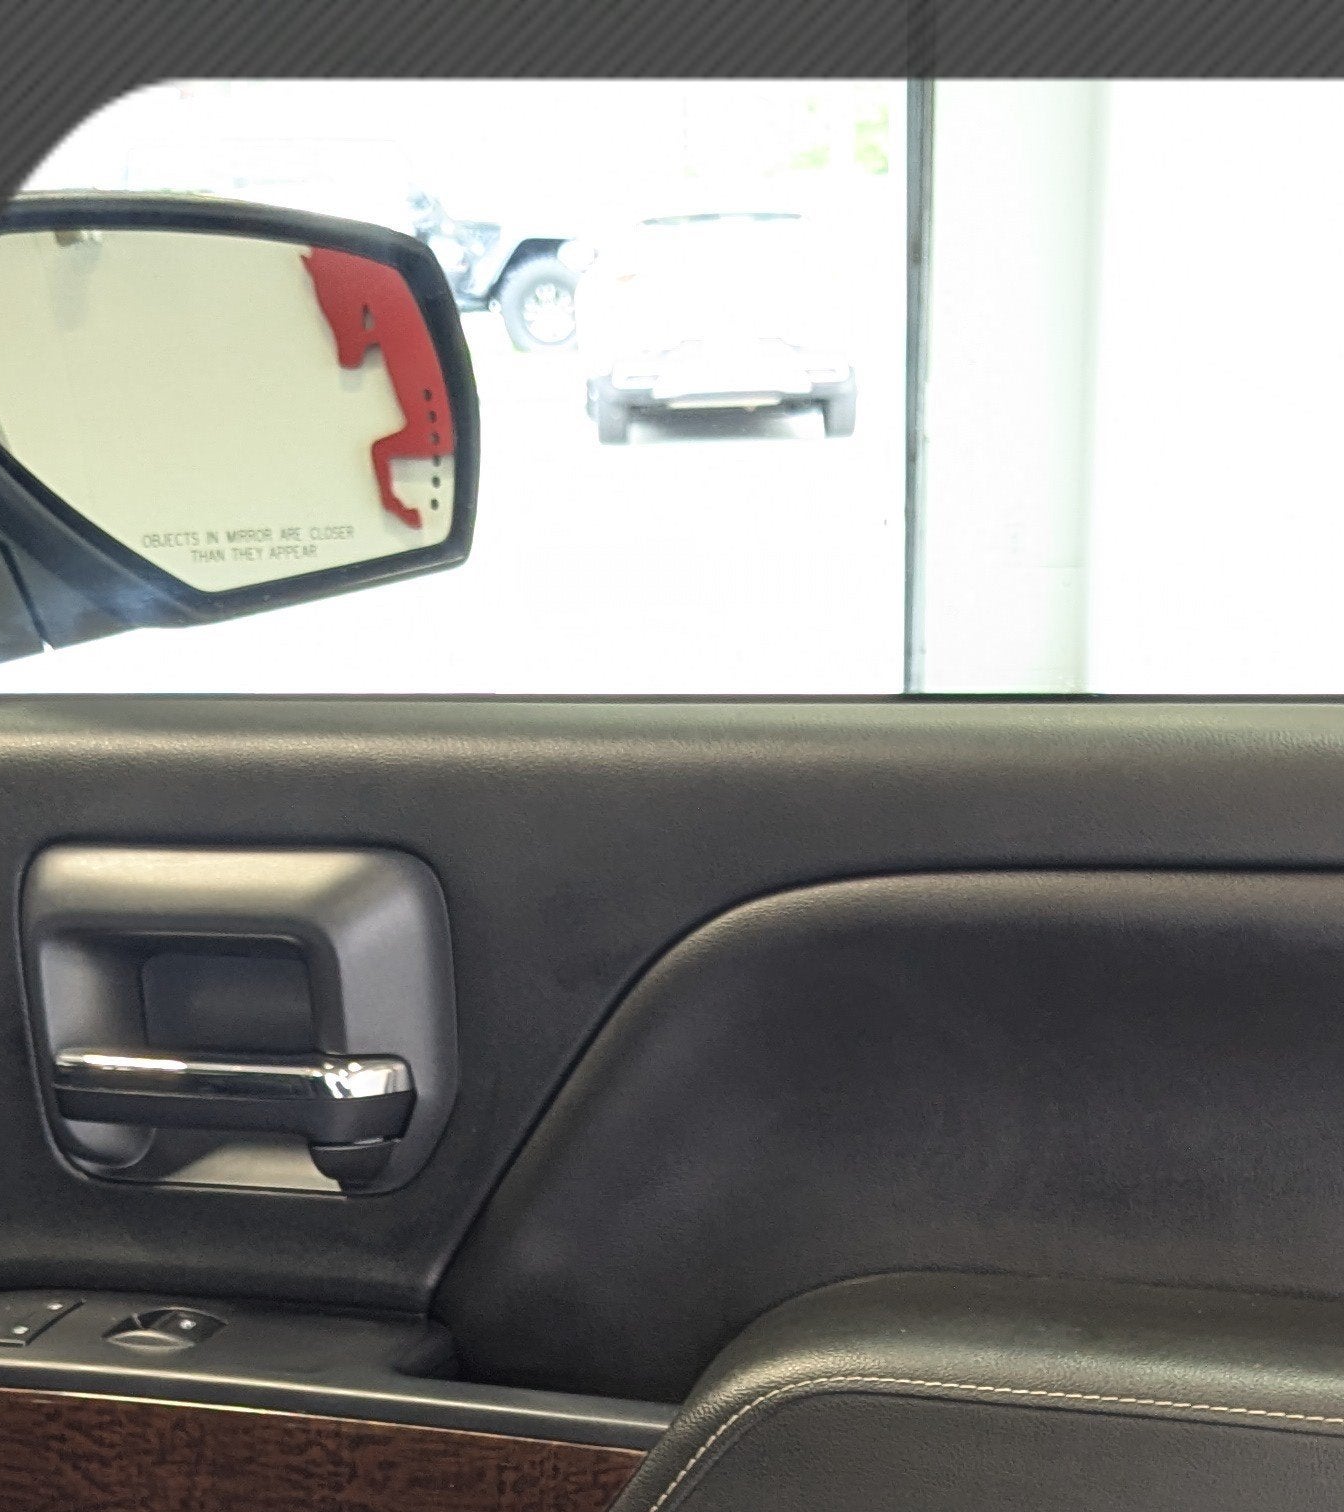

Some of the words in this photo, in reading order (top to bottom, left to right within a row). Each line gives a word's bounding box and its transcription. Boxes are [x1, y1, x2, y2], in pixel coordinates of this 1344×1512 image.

[142, 530, 201, 549] OBJECTS
[206, 530, 220, 545] IN
[226, 528, 273, 544] MIRROR
[280, 527, 301, 542] ARE
[309, 525, 355, 541] CLOSER
[191, 548, 226, 563] THAN
[232, 547, 264, 562] THEY
[269, 545, 319, 560] APPEAR
